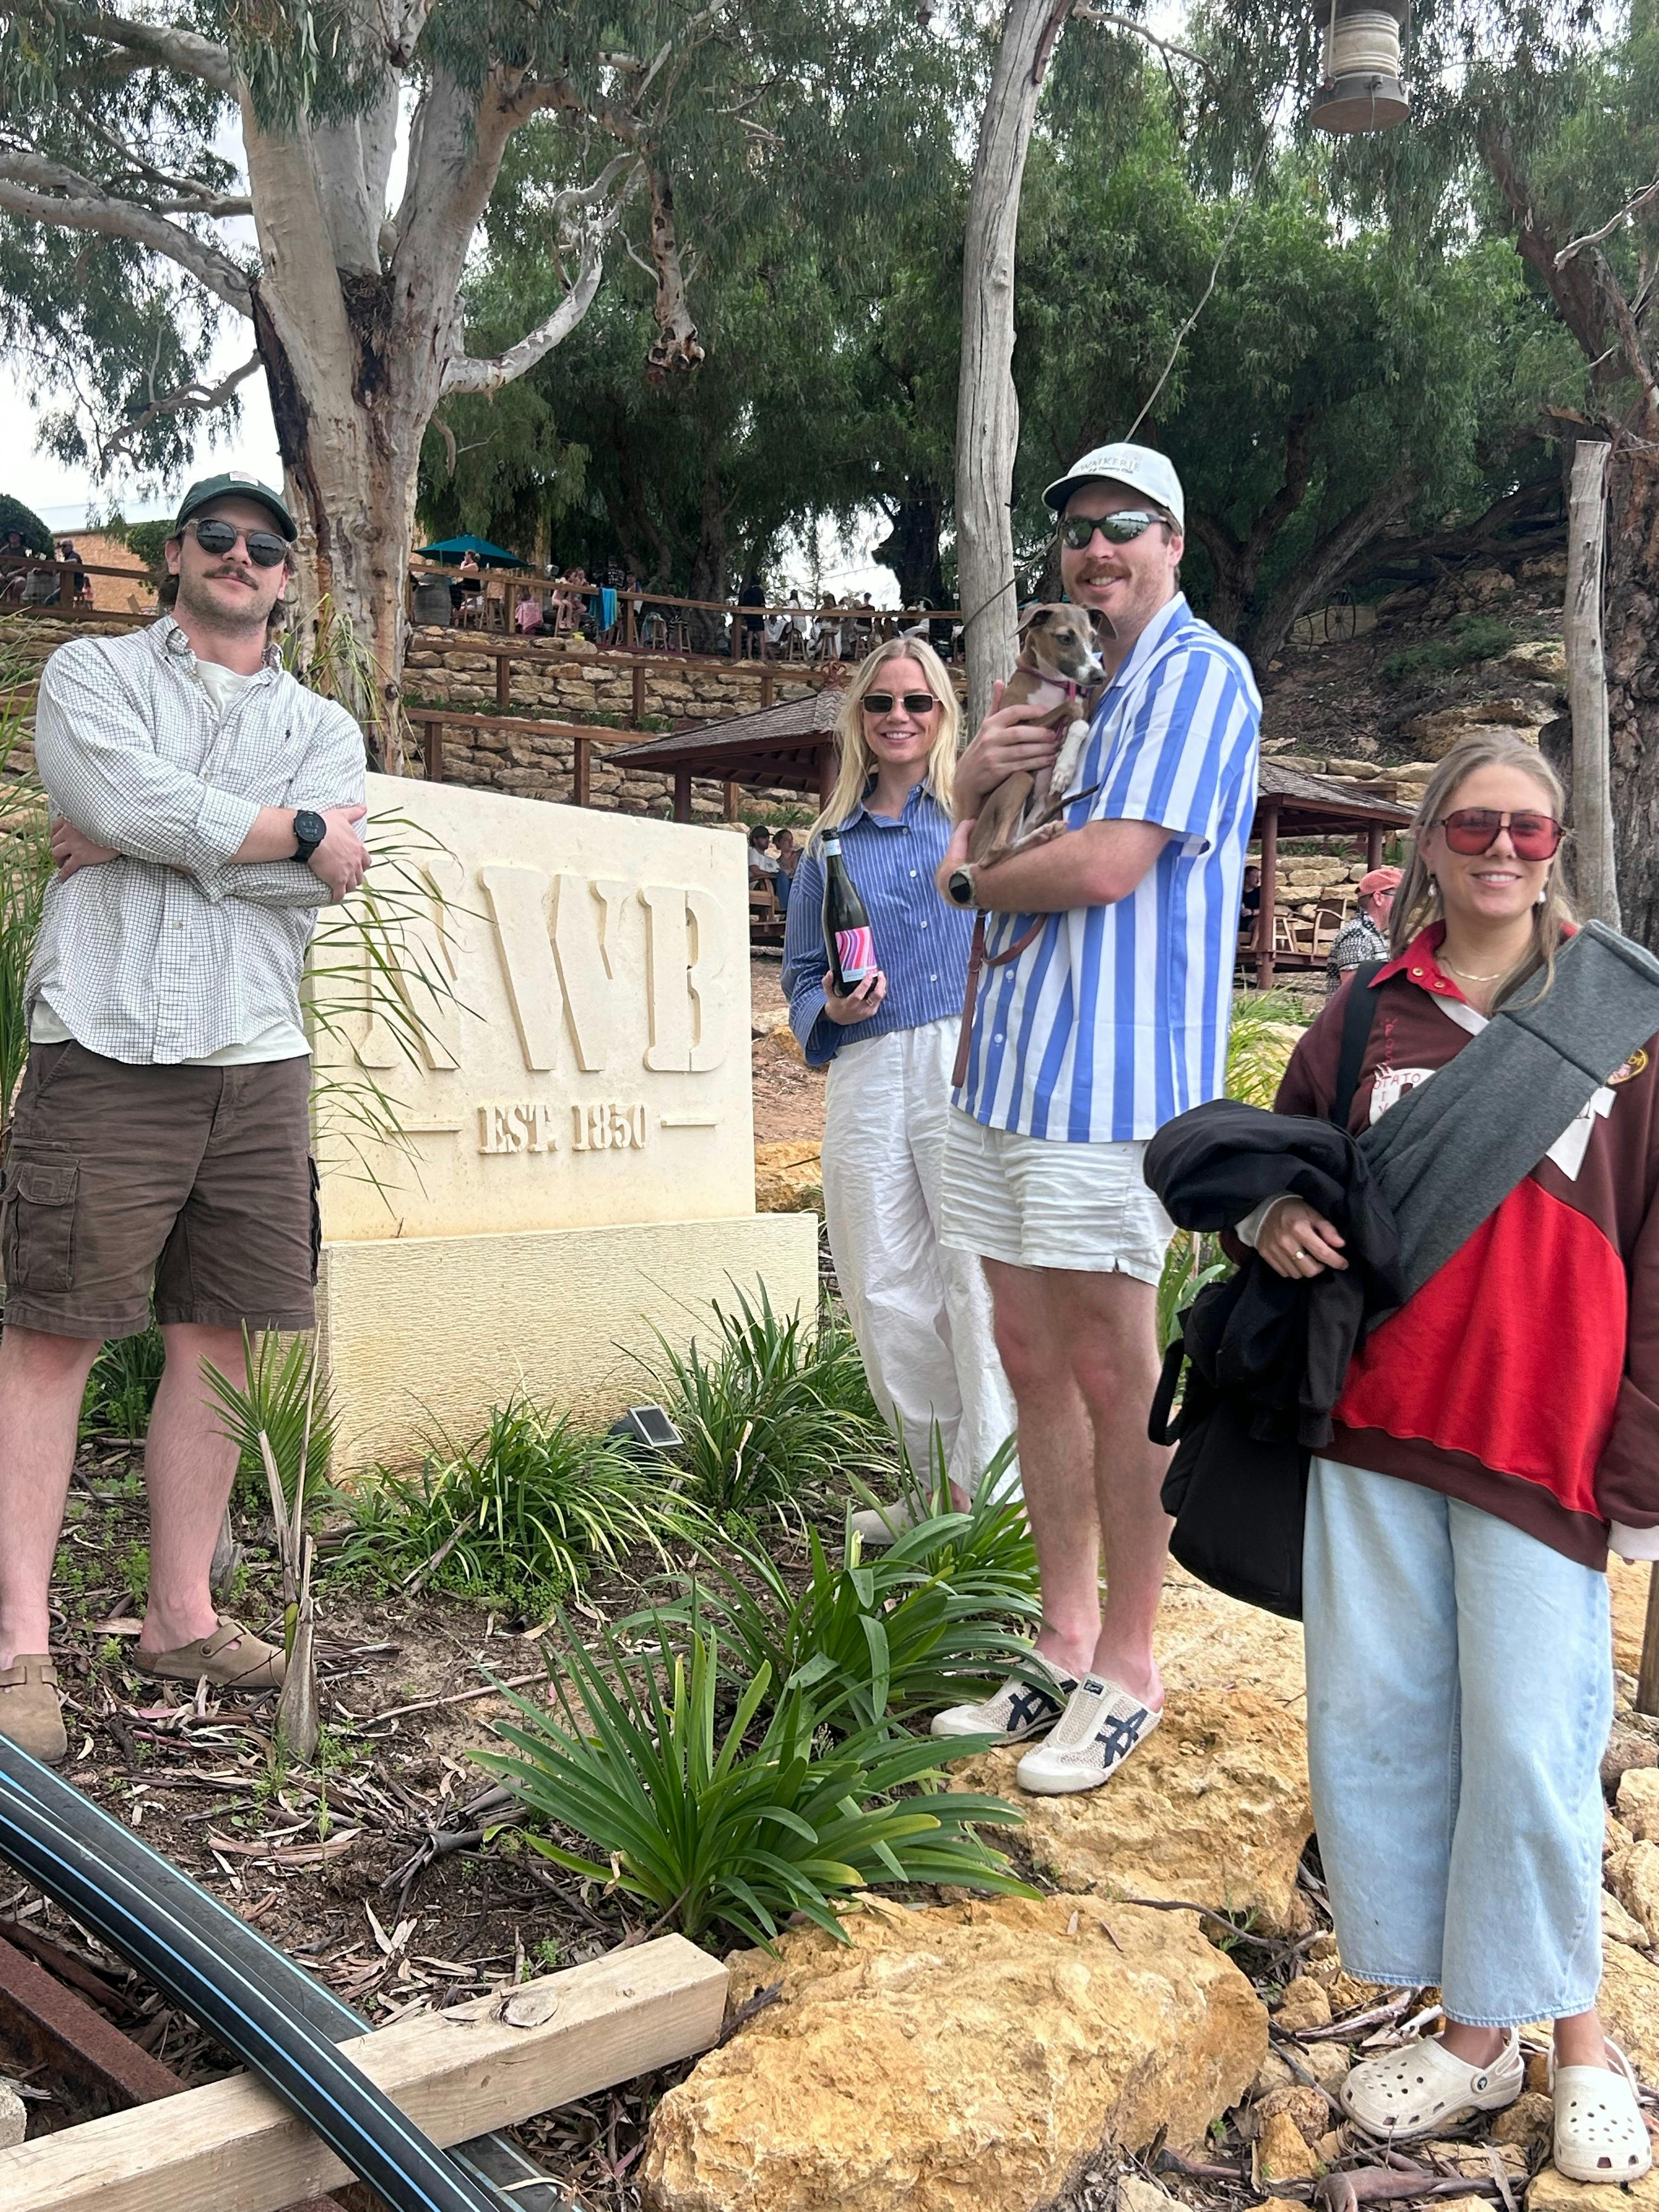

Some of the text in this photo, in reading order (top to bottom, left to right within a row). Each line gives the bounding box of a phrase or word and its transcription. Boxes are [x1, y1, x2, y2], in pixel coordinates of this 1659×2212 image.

[1080, 457, 1141, 471] WAIKERIE
[477, 1103, 647, 1154] EST. 1850
